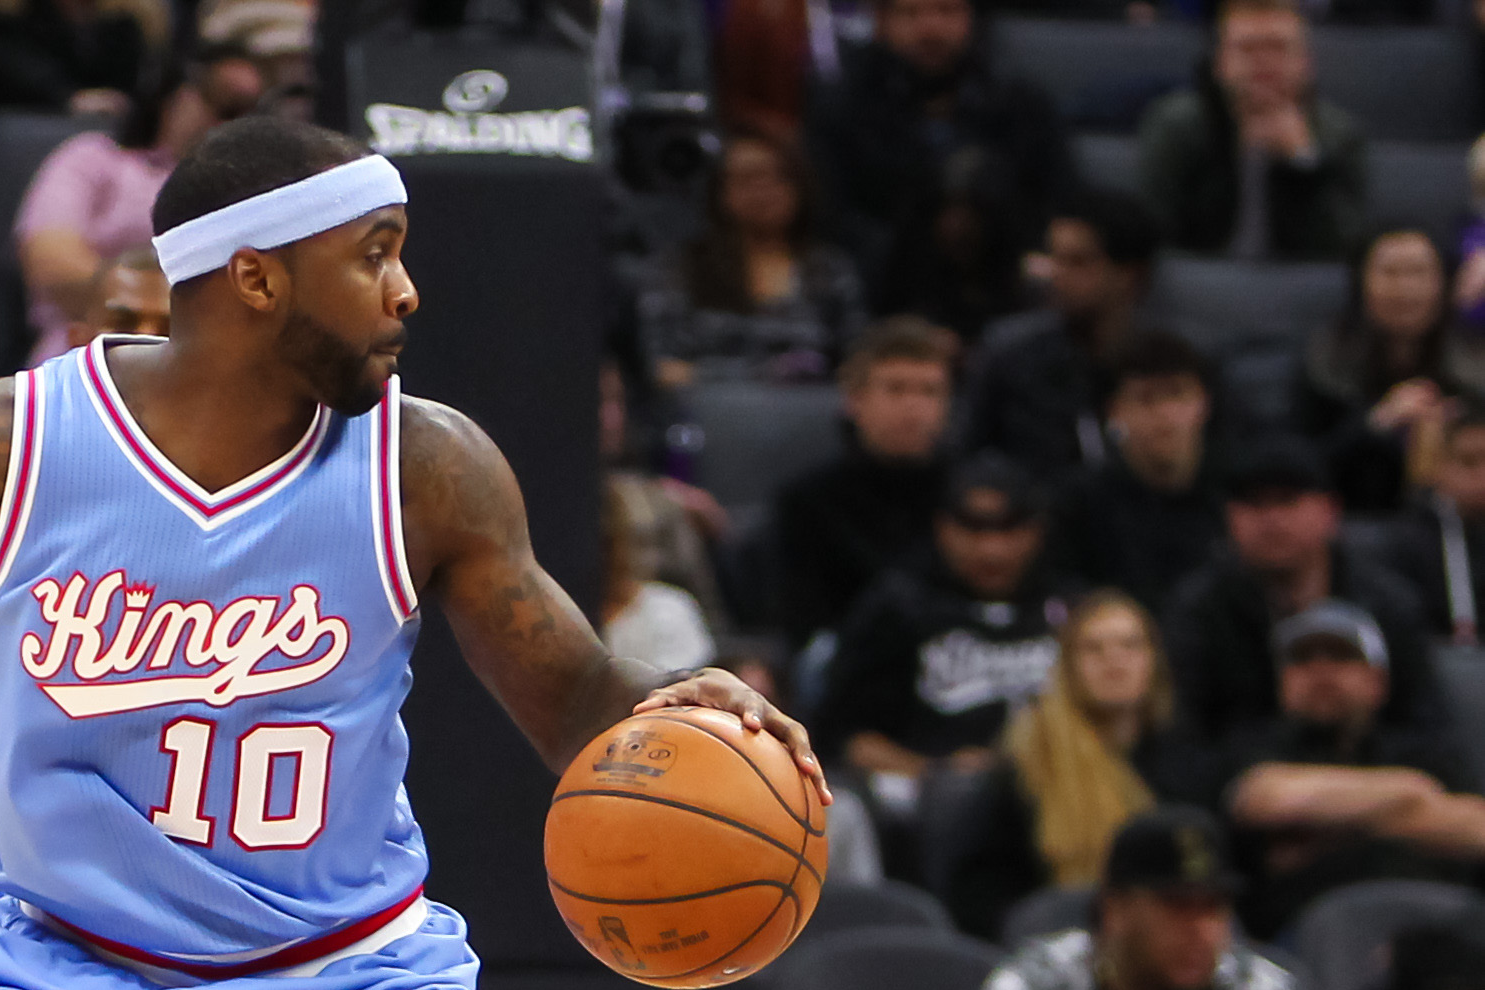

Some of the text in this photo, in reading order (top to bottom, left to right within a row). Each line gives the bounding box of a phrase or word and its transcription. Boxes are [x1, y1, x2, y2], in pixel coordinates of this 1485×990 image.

[364, 103, 595, 163] SPALDING
[20, 568, 350, 720] Kings
[148, 714, 335, 853] 10
